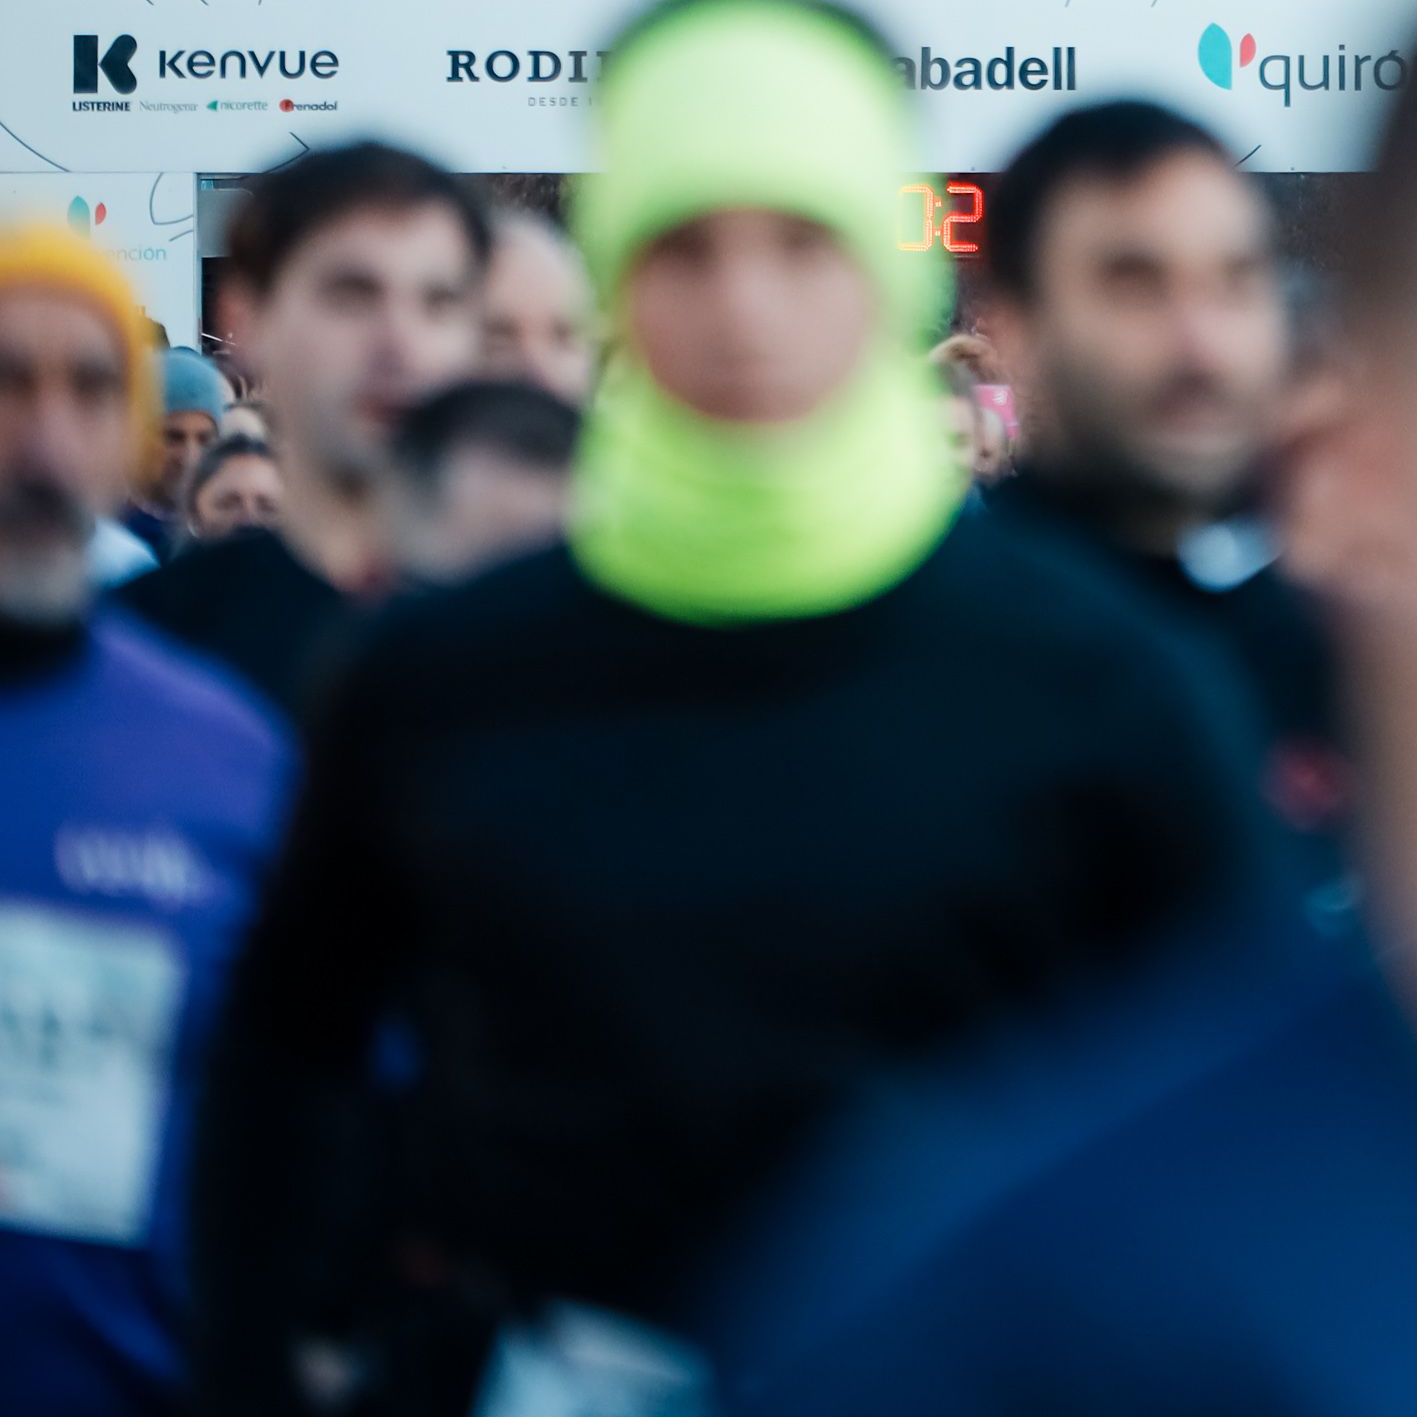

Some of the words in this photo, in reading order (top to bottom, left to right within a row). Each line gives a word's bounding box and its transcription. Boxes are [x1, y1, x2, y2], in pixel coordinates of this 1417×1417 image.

[446, 50, 609, 83] RODI
[891, 46, 1078, 91] abadell
[1258, 44, 1407, 107] quiró
[72, 101, 131, 112] LISTERINE
[527, 97, 578, 107] DESDE
